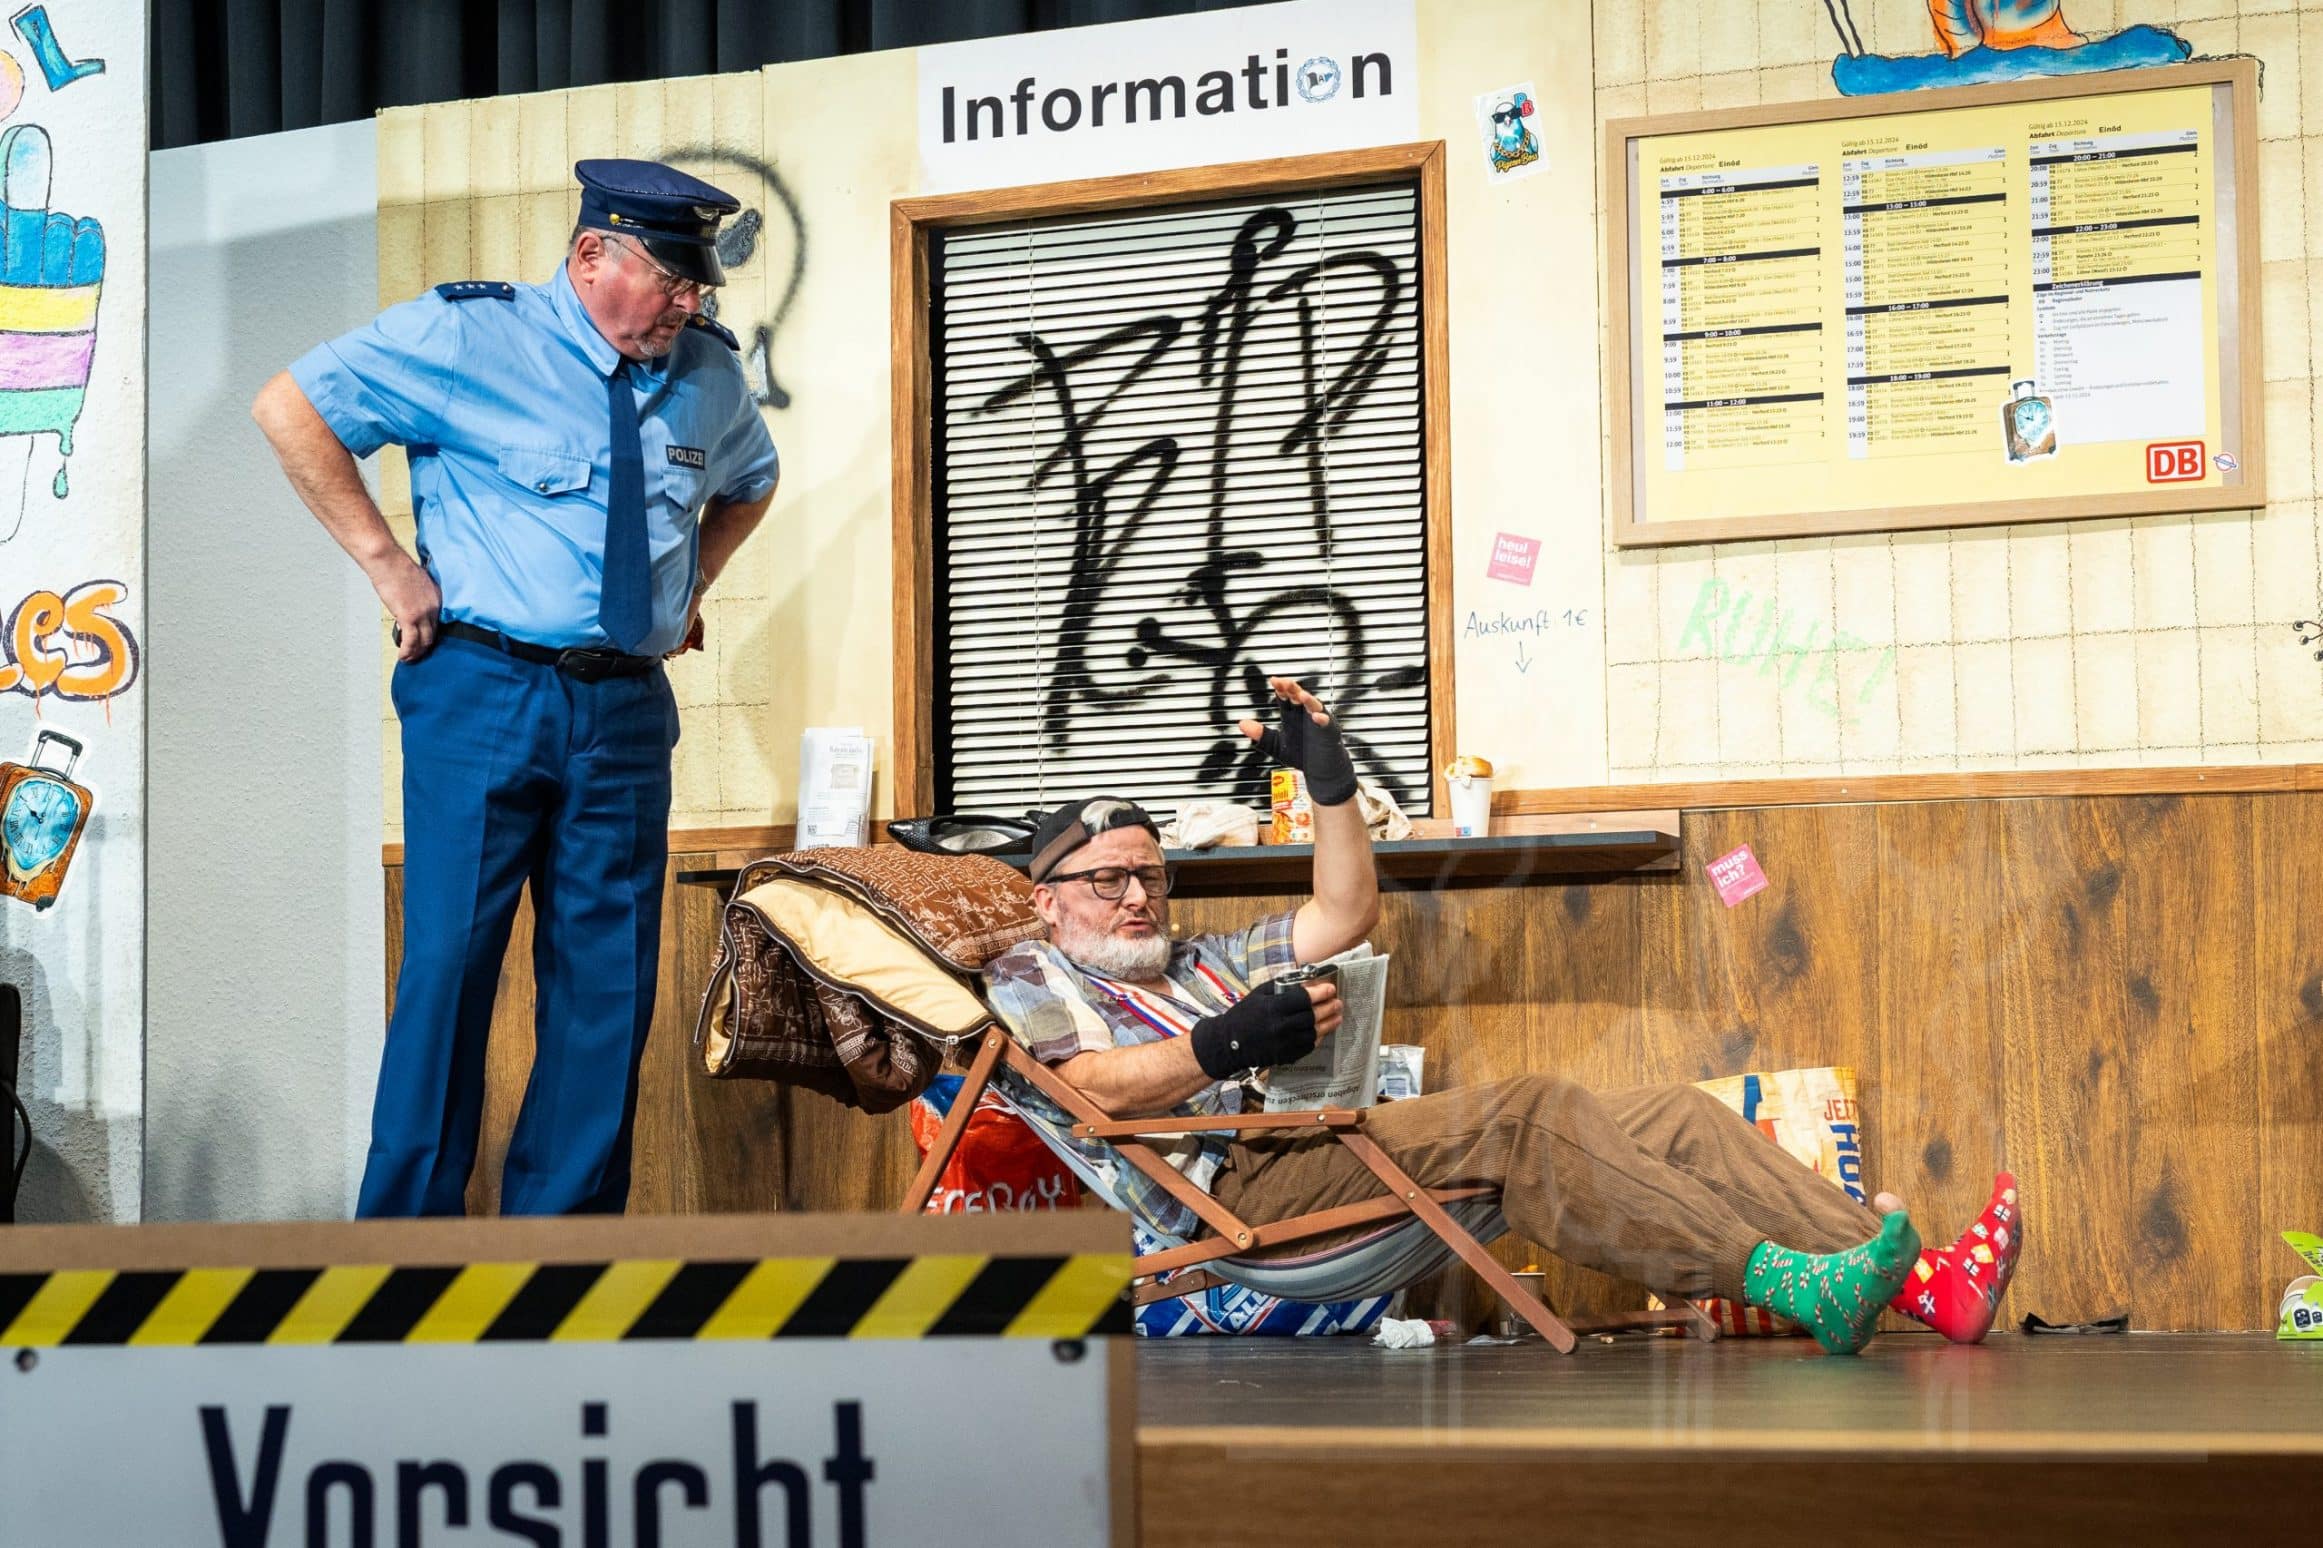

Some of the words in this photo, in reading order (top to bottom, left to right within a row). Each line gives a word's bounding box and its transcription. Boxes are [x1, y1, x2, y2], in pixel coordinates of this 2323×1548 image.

[942, 48, 1392, 143] Informatin
[1660, 165, 1684, 173] Abfahrt
[2154, 448, 2198, 477] DB
[1497, 537, 1528, 553] heul
[1464, 609, 1551, 639] Auskunft
[199, 1400, 877, 1548] Vorsicht
